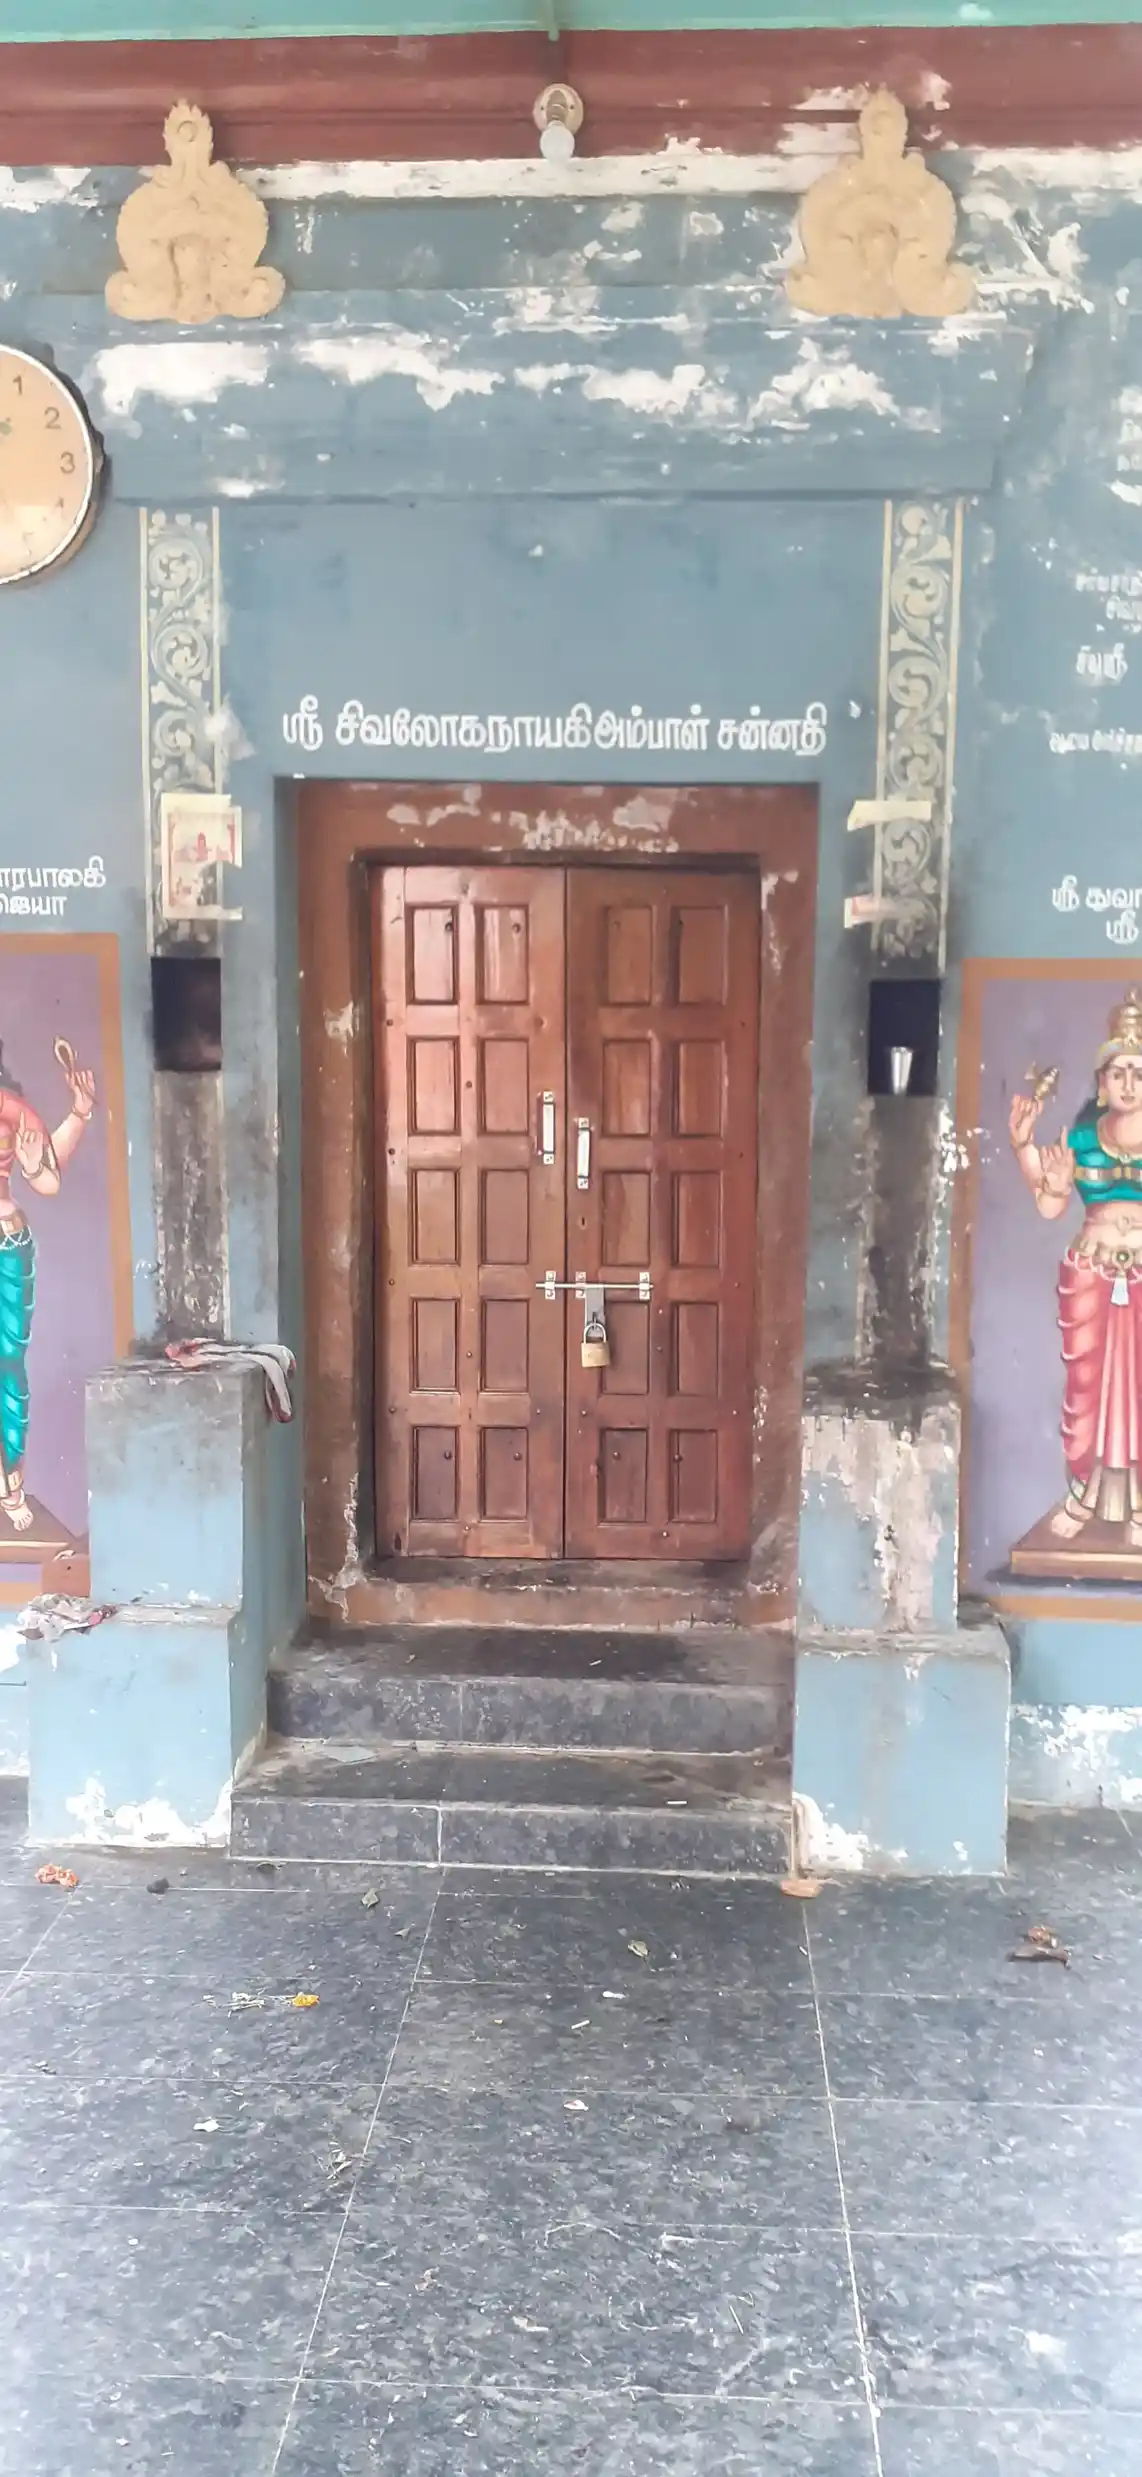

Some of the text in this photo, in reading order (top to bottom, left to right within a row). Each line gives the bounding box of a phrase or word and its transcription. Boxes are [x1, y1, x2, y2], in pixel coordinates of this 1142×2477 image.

[44, 406, 61, 430] 2
[60, 451, 76, 475] 3
[283, 694, 323, 751] ஸ்ரீ
[717, 701, 828, 756] சன்னதி
[1051, 874, 1080, 912] ஸ்ரீ
